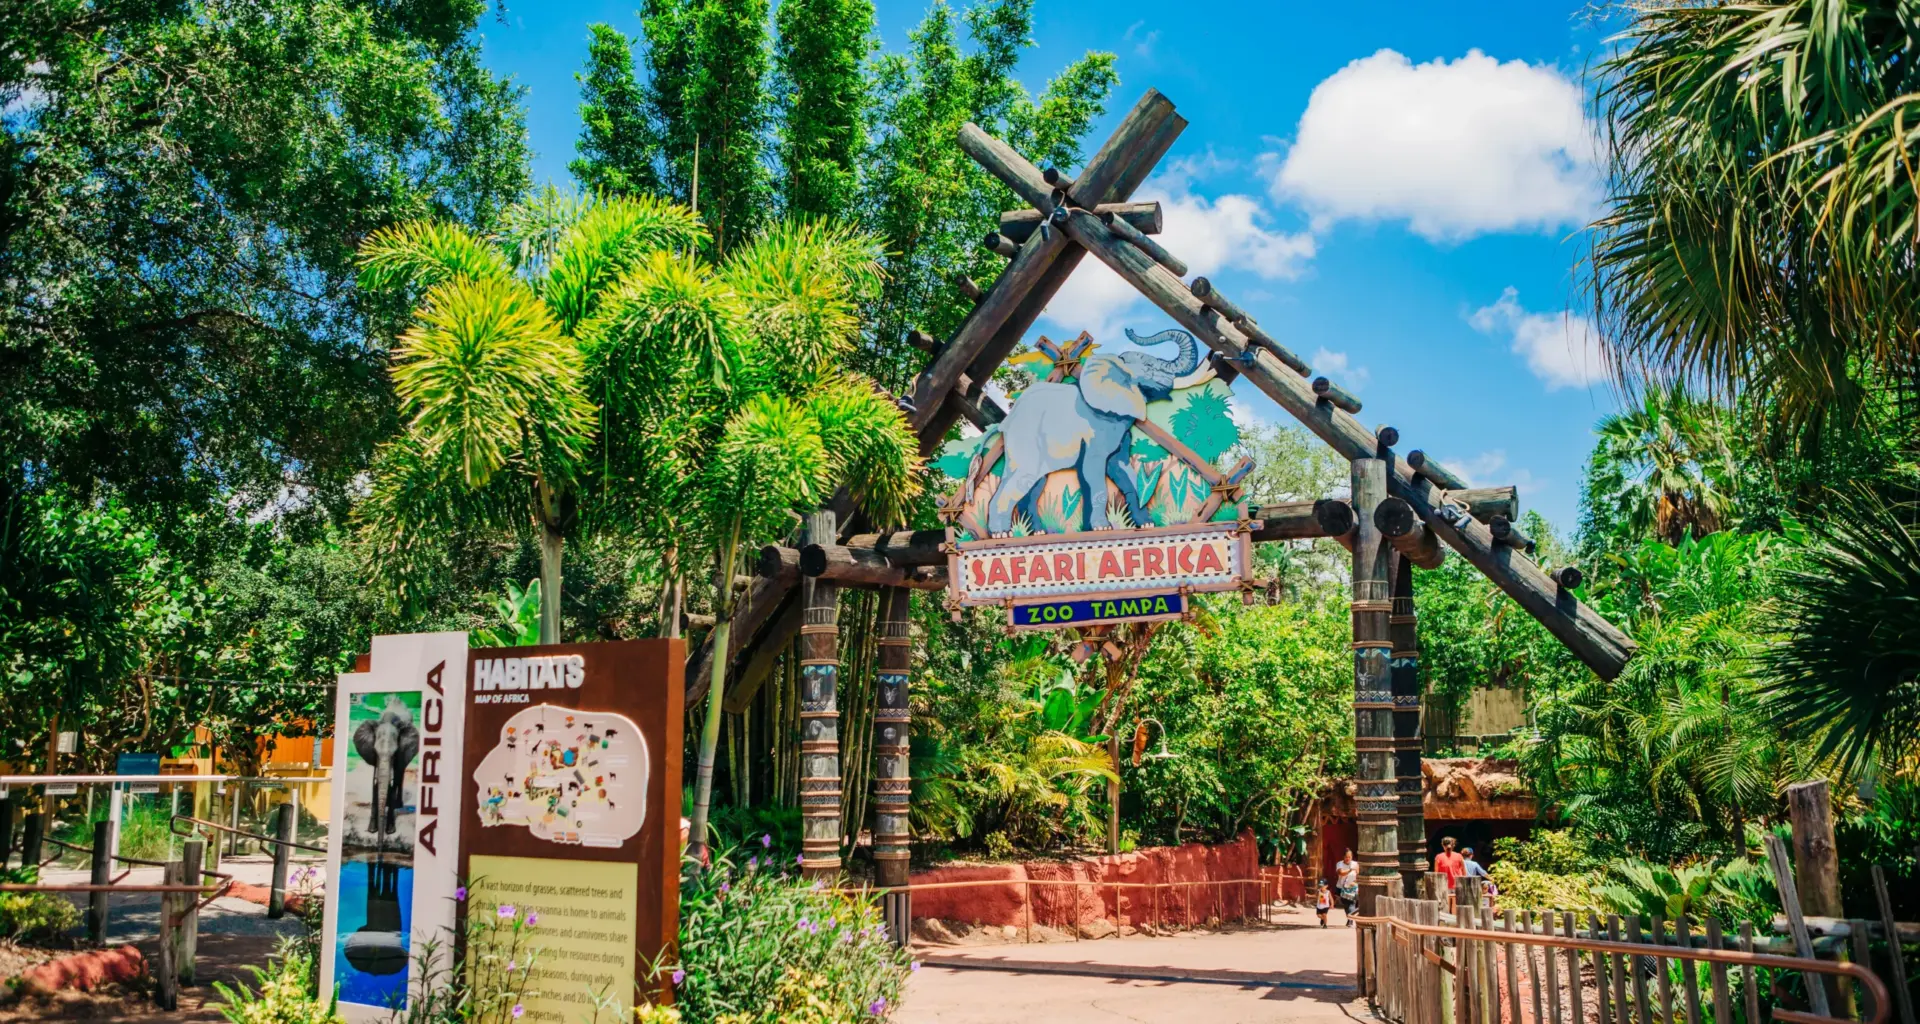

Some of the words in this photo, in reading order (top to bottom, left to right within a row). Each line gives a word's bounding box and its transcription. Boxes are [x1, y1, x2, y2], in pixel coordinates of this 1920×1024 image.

[971, 552, 1085, 587] SAFARI
[1098, 543, 1223, 579] AFRICA
[1027, 605, 1074, 624] ZOO
[1091, 597, 1169, 618] TAMPA
[474, 654, 585, 691] HABITATS
[475, 694, 491, 704] MAP
[492, 694, 502, 703] OF
[503, 693, 530, 703] AFRICA
[418, 659, 446, 857] AFRICA
[480, 880, 485, 889] A
[486, 881, 499, 891] vast
[500, 881, 524, 893] horizon
[525, 882, 532, 893] of
[533, 885, 558, 897] grasses,
[560, 885, 590, 897] scattered
[591, 887, 608, 898] trees
[609, 888, 623, 899] and
[563, 907, 569, 917] is
[570, 906, 589, 918] home
[591, 908, 598, 919] to
[600, 908, 626, 921] animals
[560, 926, 572, 938] and
[574, 929, 608, 942] carnivores
[609, 930, 628, 944] share
[559, 947, 568, 959] for
[569, 950, 600, 962] resources
[602, 951, 625, 968] during
[570, 969, 593, 986] during
[541, 988, 561, 1001] inches
[563, 991, 576, 1003] and
